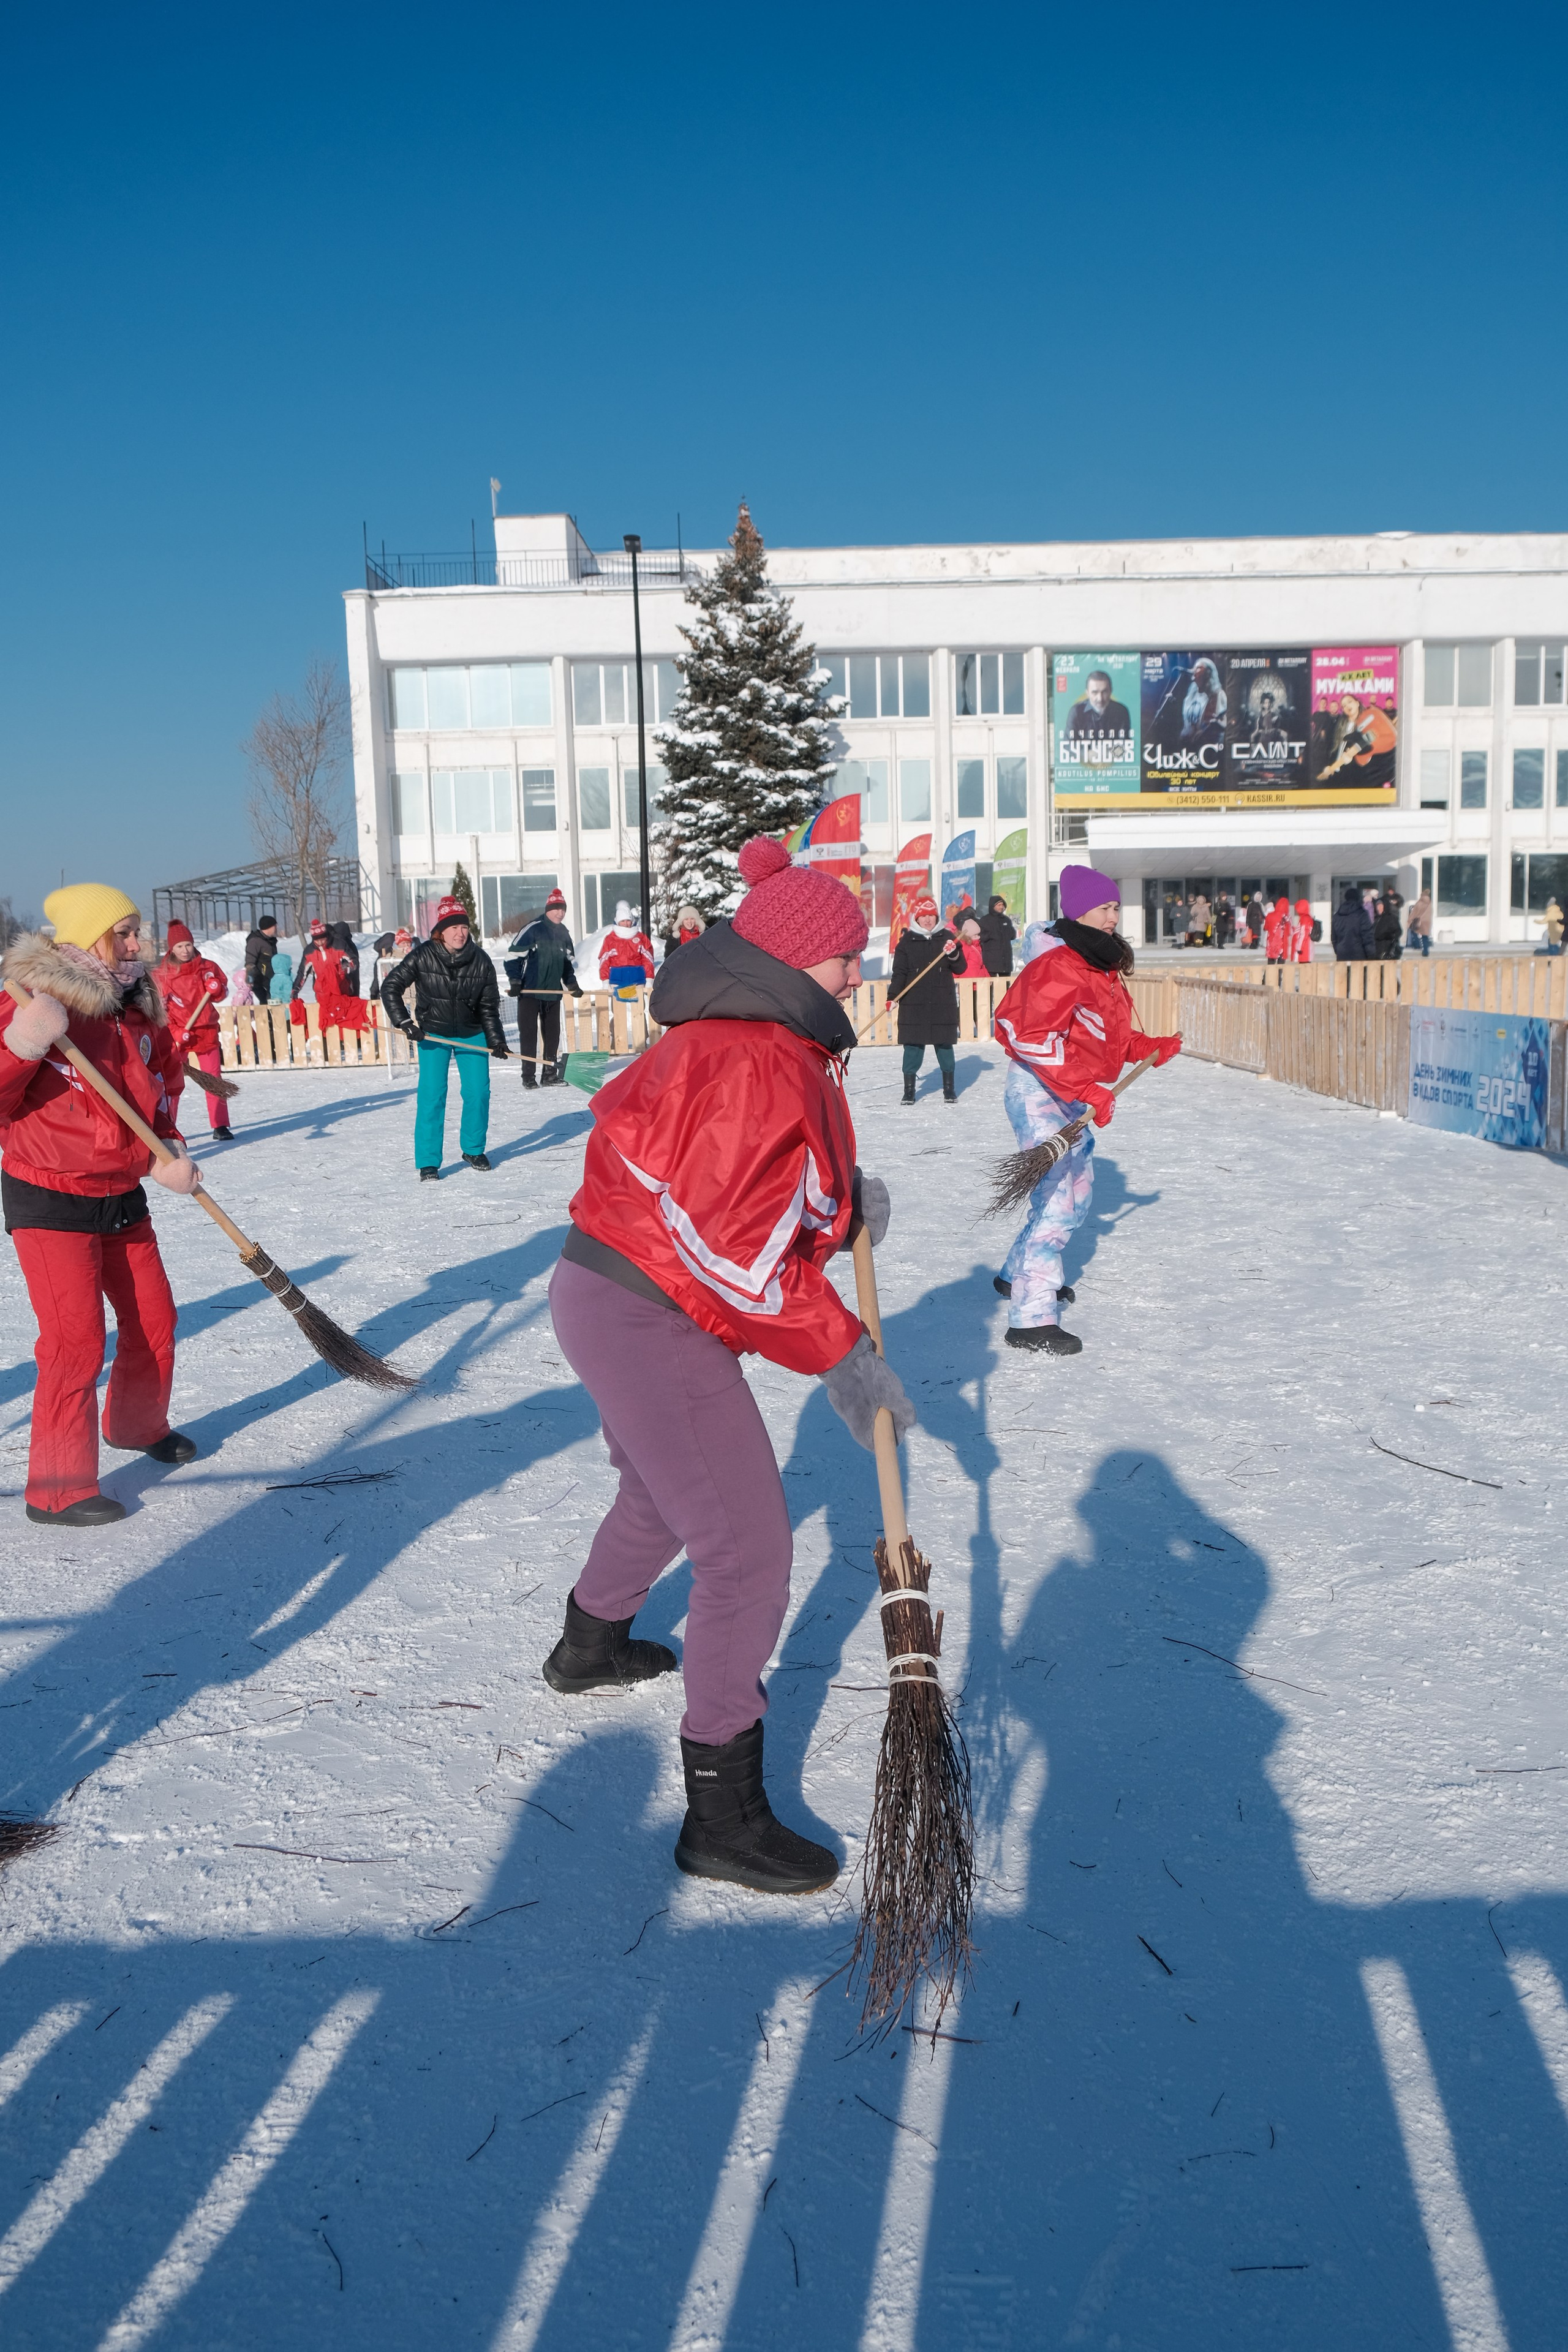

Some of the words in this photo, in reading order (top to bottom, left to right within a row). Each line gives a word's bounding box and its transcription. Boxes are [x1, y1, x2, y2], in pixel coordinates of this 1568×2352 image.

[1061, 655, 1074, 666] 23
[1146, 657, 1162, 667] 29
[1231, 658, 1240, 669] 20
[1241, 658, 1265, 668] АПРЕЛЯ
[1316, 656, 1345, 666] 28.04
[1316, 677, 1395, 695] МУРАКАМИ
[1059, 729, 1134, 739] ВЯЧЕСЛАВ
[1177, 796, 1199, 805] (3412)
[1202, 795, 1229, 804] 550-111
[1414, 1063, 1434, 1080] ДЕНЬ
[1436, 1066, 1472, 1088] ЗИМНИХ
[1413, 1082, 1440, 1102] ВИДОВ
[1442, 1088, 1473, 1110] СПОРТА
[1476, 1074, 1531, 1122] 2024
